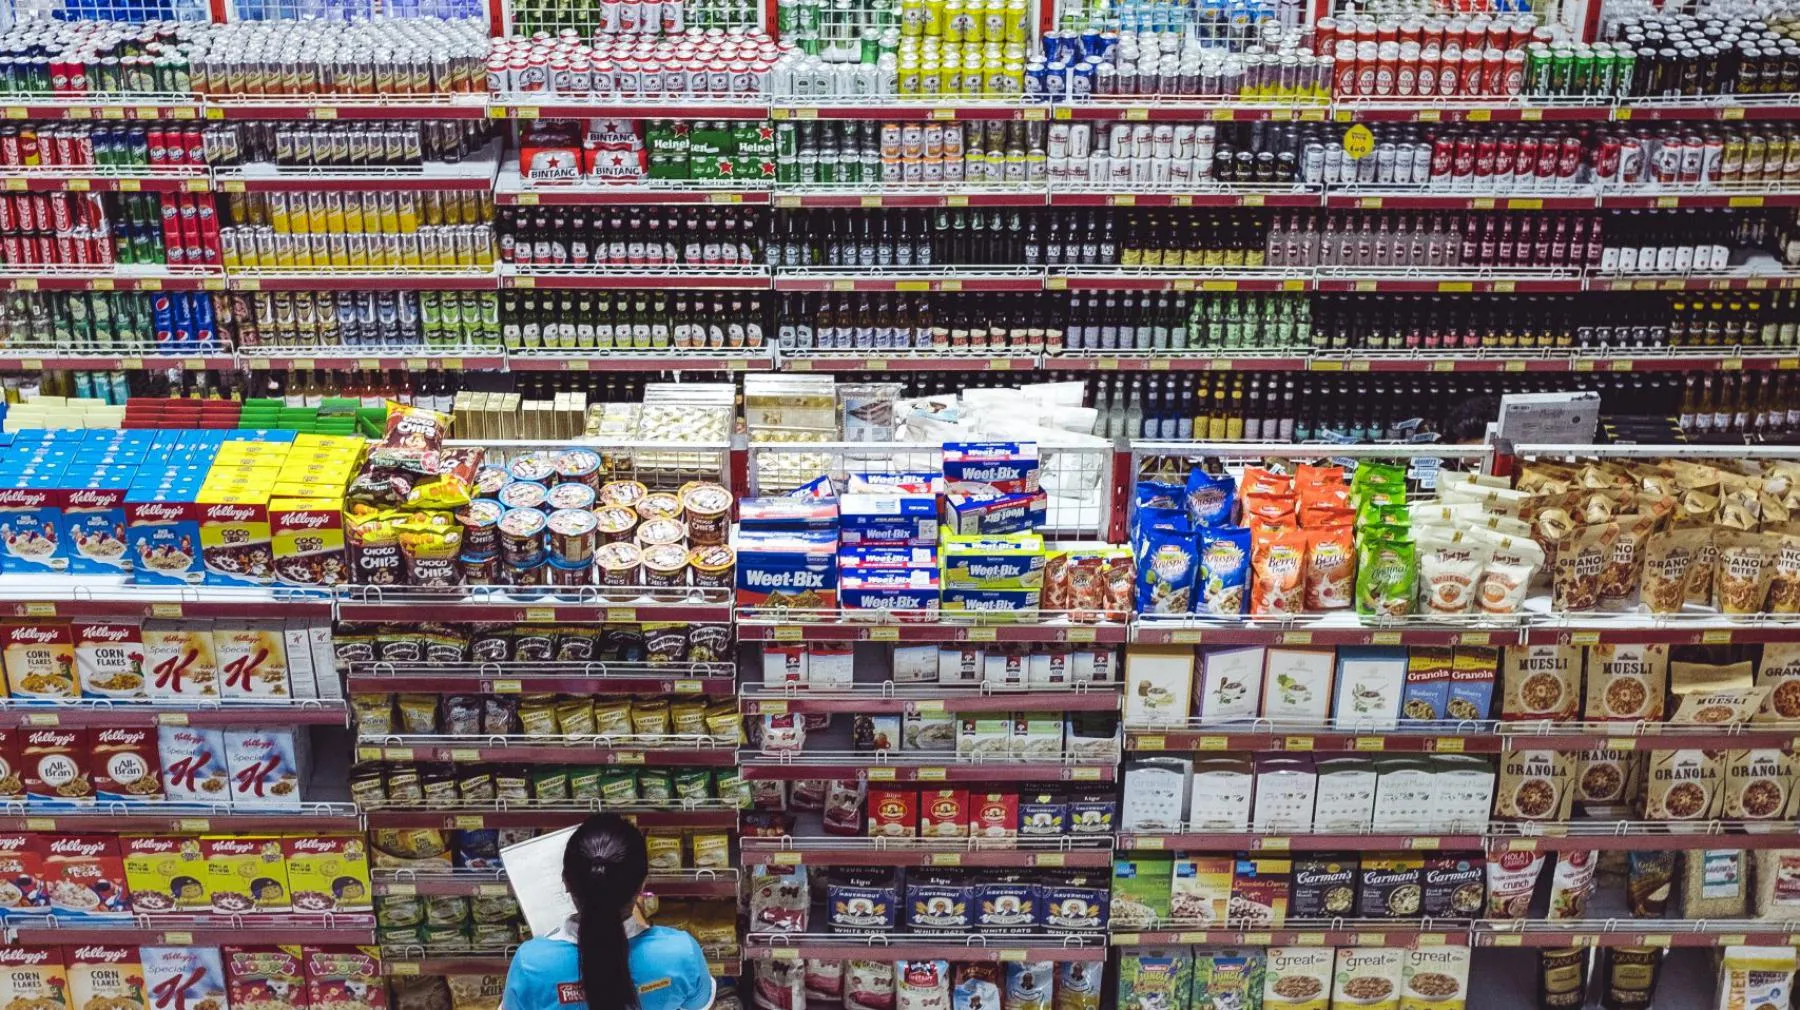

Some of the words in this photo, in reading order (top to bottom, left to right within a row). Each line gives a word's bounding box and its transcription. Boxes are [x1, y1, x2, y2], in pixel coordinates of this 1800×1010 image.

[590, 133, 634, 142] BINTANG
[531, 168, 576, 179] BINTANG
[596, 167, 640, 176] BINTANG
[397, 421, 436, 438] CHIPS
[962, 466, 1020, 480] Weet-Bix
[868, 475, 925, 485] Weet-Bix
[70, 490, 117, 506] Kellogg's
[136, 503, 183, 519] Kellogg's
[208, 505, 255, 519] Kellogg's
[281, 512, 330, 528] Kellogg's
[866, 528, 911, 539] Weet-Bix
[363, 547, 396, 556] CHOCO
[360, 556, 399, 569] CHIPS
[416, 560, 448, 568] CHOCO
[1560, 555, 1606, 567] GRANOL
[414, 566, 453, 579] CHIPS
[969, 564, 1020, 576] Weet-Bix
[1576, 566, 1600, 575] BITES
[1664, 567, 1685, 575] BITE
[1731, 567, 1757, 575] BITES
[746, 569, 825, 588] Weet-Bix
[861, 595, 920, 608] Weet-Bix
[965, 600, 1016, 610] Weet-Bix
[11, 627, 59, 642] Kellogg's
[83, 626, 129, 642] Kellogg's
[26, 651, 50, 659] CORN
[95, 649, 124, 658] CORN
[97, 657, 126, 666] FLAKES
[1519, 657, 1568, 671] MUESLI
[1452, 669, 1493, 680] Granola
[1603, 662, 1653, 675] MUESLI
[1765, 666, 1800, 677] GRAN
[1408, 669, 1449, 681] Granola
[1696, 697, 1747, 706] MUESLI
[29, 731, 76, 745] Kellogg's
[99, 729, 145, 744] Kellogg's
[49, 761, 67, 770] All-
[119, 759, 136, 769] All-
[45, 768, 71, 777] Bran
[115, 767, 140, 775] Bran
[1506, 764, 1567, 777] GRANOLA
[1655, 767, 1717, 780] GRANOLA
[1731, 765, 1792, 777] GRANOLA
[51, 838, 105, 855] Kellogg's
[131, 838, 173, 850] Kellogg's
[212, 841, 254, 853] Kellogg's
[294, 839, 337, 851] Kellogg's
[1297, 870, 1352, 884] Carman's
[1363, 870, 1419, 884] Carman's
[1427, 868, 1482, 883] Carman's
[1503, 880, 1529, 889] crunch
[0, 949, 47, 963] Kellogg's
[75, 946, 128, 962] Kellogg's
[1411, 951, 1451, 968] great
[1276, 953, 1315, 971] great
[1346, 953, 1386, 972] great
[11, 972, 40, 980] CORN
[91, 970, 119, 979] CORN
[148, 965, 187, 975] Special
[13, 980, 42, 988] FLAKES
